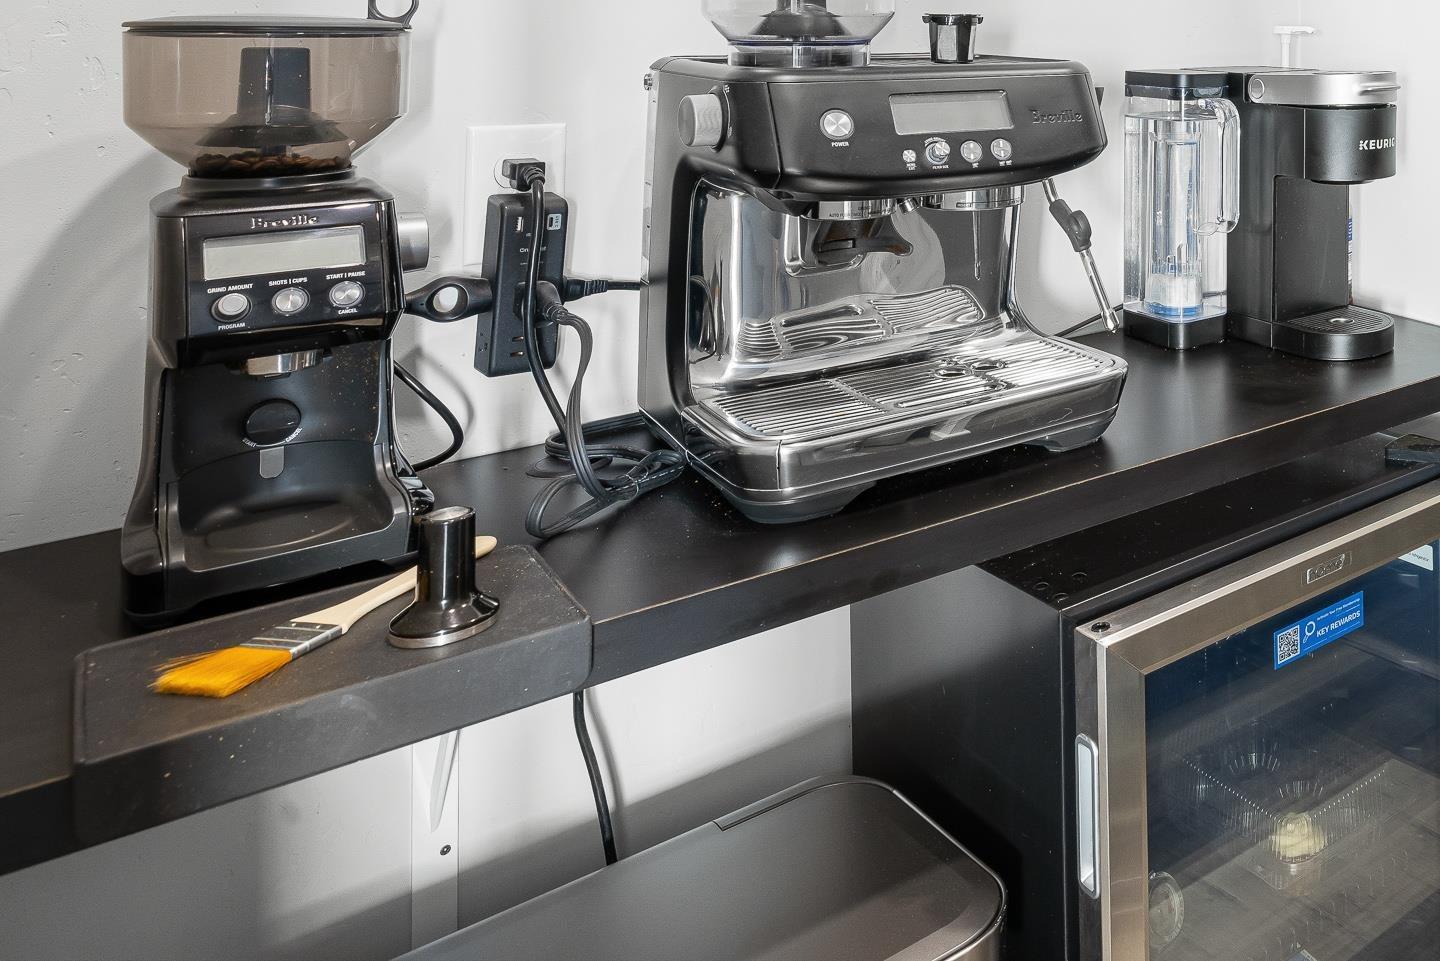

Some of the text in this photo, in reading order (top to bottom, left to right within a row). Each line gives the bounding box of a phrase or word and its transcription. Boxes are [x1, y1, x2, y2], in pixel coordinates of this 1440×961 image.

[1031, 109, 1083, 124] Breville
[251, 214, 318, 229] Breville
[347, 270, 366, 278] PAUSE
[268, 276, 308, 287] SHOTS CUPS
[207, 283, 254, 294] GRIND AMOUNT
[338, 307, 358, 315] CANCEL
[217, 322, 246, 331] PROGRAM
[1316, 610, 1361, 638] KEY REWARDS
